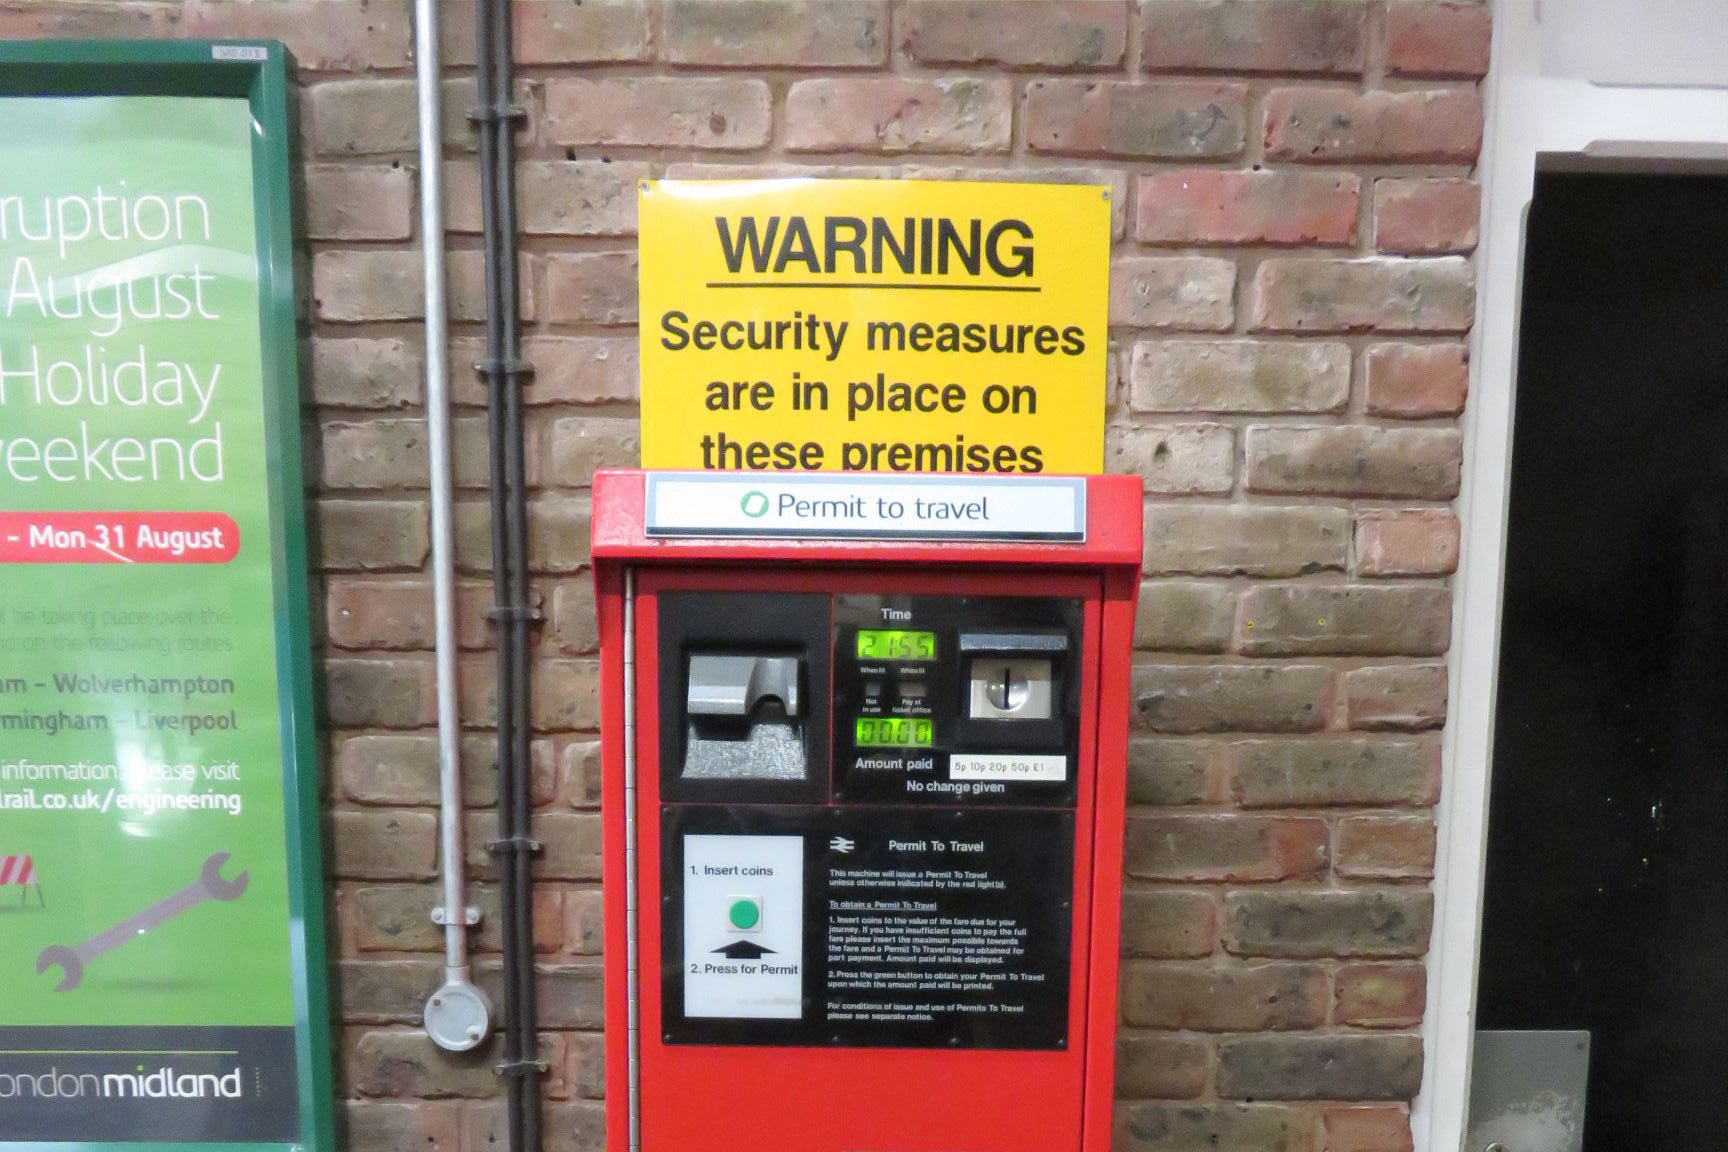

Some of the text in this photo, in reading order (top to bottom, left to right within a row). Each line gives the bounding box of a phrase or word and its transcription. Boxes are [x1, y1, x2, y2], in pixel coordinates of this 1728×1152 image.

[0, 180, 210, 259] ruption
[714, 216, 1035, 278] WARNING
[7, 257, 220, 337] August
[660, 311, 1086, 361] Security measures
[0, 344, 221, 424] Holiday
[705, 372, 1037, 421] are in place on
[0, 421, 223, 482] eekend
[700, 432, 1044, 473] these premises
[778, 493, 989, 521] Permit to travel
[30, 525, 86, 548] Mon
[94, 525, 124, 549] 31
[137, 525, 224, 555] August
[881, 608, 912, 620] Time
[53, 673, 234, 700] Wolverhampton
[135, 709, 238, 736] Liverpool
[137, 760, 195, 780] ease
[201, 760, 240, 780] visit
[855, 757, 933, 772] Amount paid
[954, 758, 1044, 773] 5p 10p 20p 50p £1
[906, 780, 1005, 796] No change given
[888, 840, 984, 852] Permit To Travel
[690, 865, 774, 876] 1. Insert coins
[847, 870, 880, 878] machine
[965, 871, 988, 879] Travel
[963, 880, 975, 888] red
[874, 901, 900, 909] Permit
[862, 916, 882, 924] coins
[940, 917, 952, 925] the
[870, 927, 884, 935] you
[828, 953, 844, 962] part
[919, 954, 936, 963] paid
[690, 964, 799, 975] 2. Press for Permit
[897, 971, 923, 979] button
[980, 972, 1006, 980] Permit
[842, 1002, 882, 1010] conditions
[1000, 1004, 1024, 1012] Travel
[103, 1065, 241, 1098] midland
